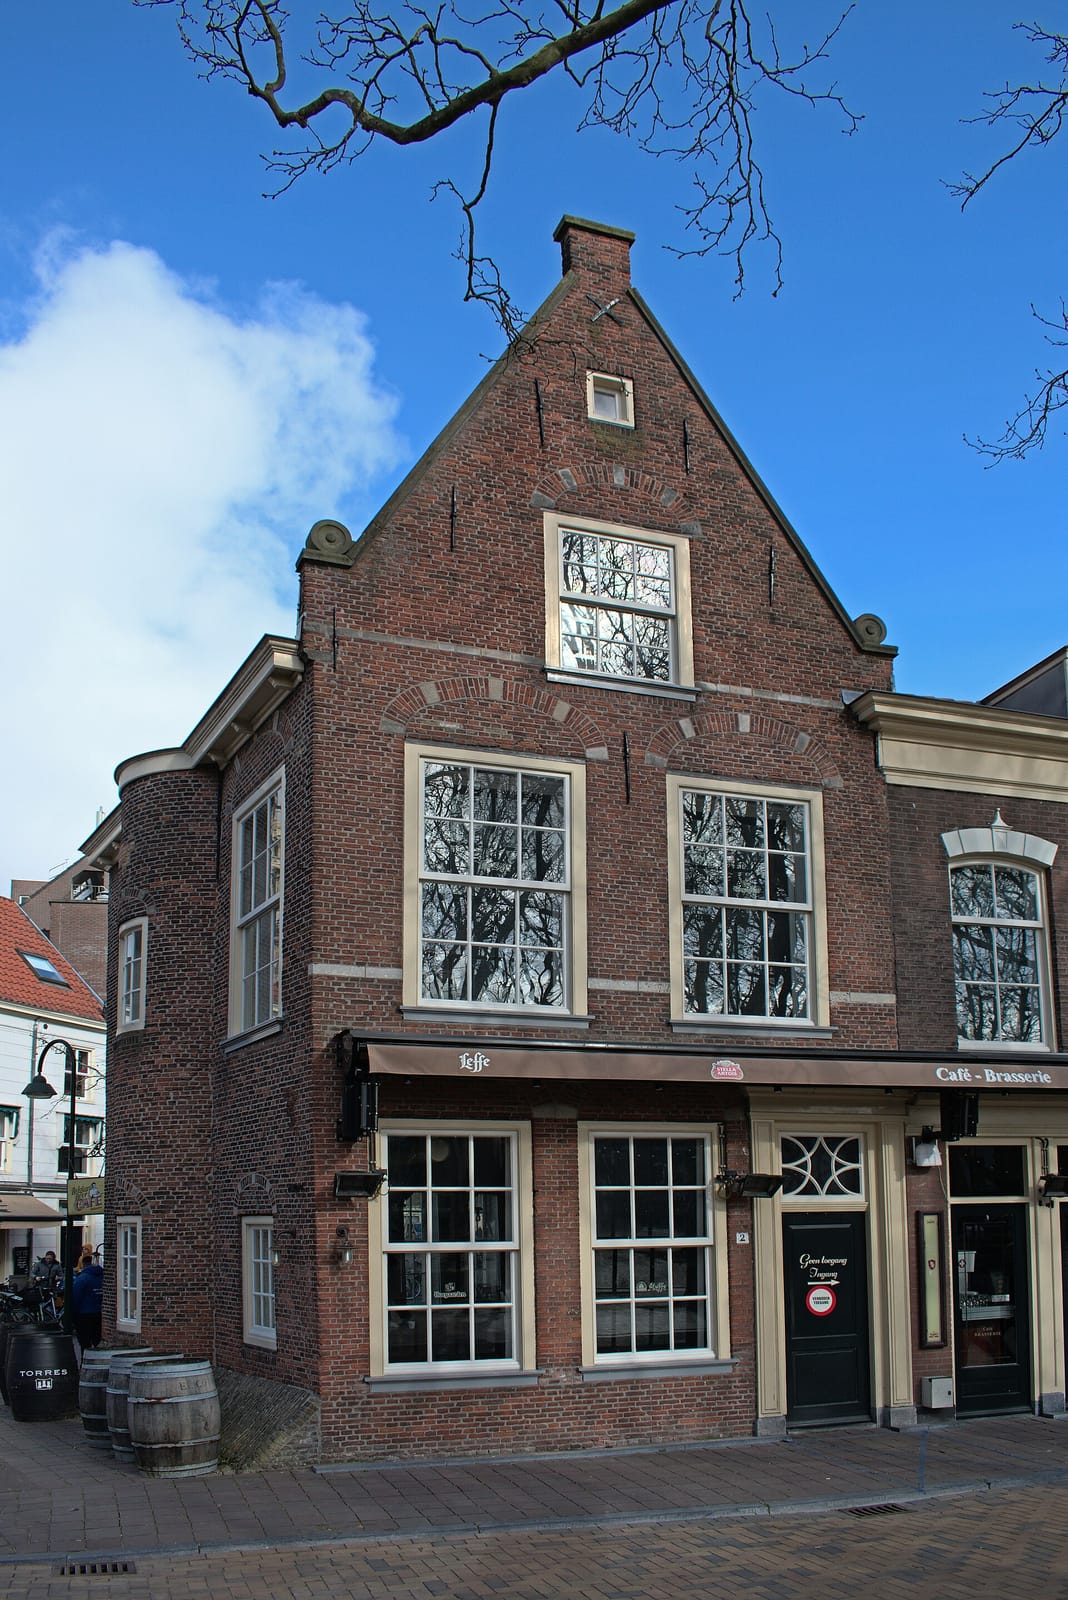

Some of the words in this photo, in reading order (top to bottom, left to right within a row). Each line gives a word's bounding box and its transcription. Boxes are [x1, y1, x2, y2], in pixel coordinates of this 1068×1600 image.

[459, 1051, 491, 1073] Leffe
[936, 1067, 972, 1082] Café
[983, 1069, 1053, 1084] Brasserie
[739, 1233, 746, 1242] 2
[799, 1253, 820, 1269] Geen
[821, 1255, 848, 1266] toegang
[809, 1266, 838, 1280] Ingang
[19, 1368, 68, 1377] TORRES
